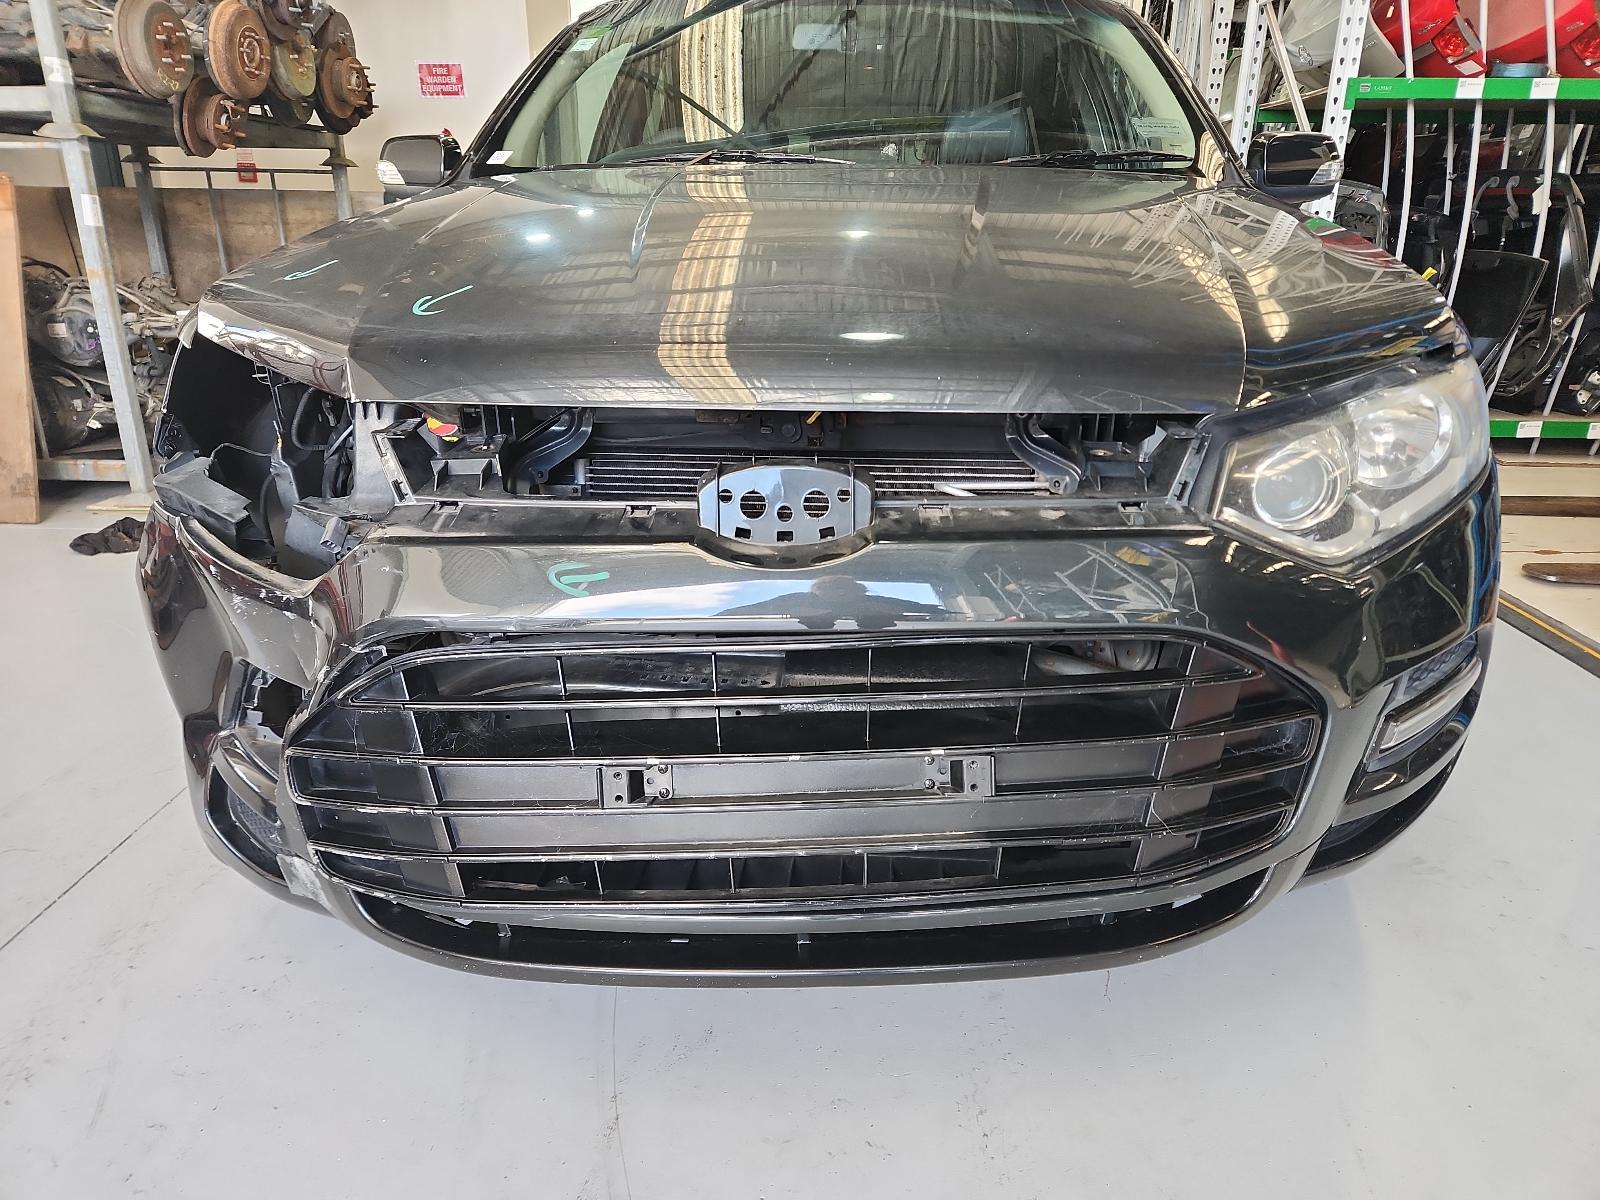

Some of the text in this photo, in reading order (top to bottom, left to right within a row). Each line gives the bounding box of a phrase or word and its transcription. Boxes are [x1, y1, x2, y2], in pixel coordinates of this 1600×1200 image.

[432, 67, 449, 75] FIRE
[427, 75, 457, 84] WARDEN
[421, 84, 462, 93] EQUIPMENT
